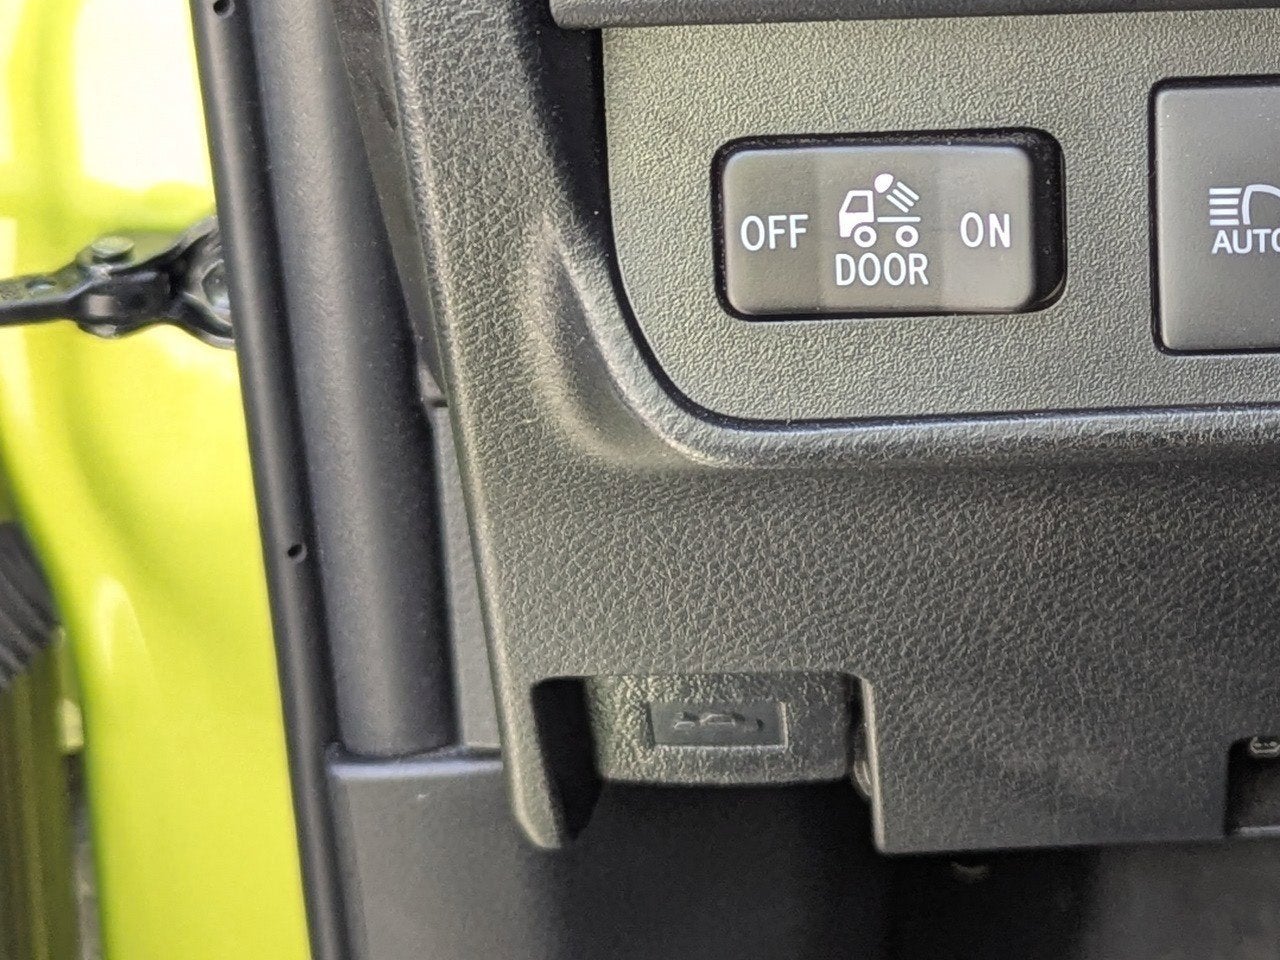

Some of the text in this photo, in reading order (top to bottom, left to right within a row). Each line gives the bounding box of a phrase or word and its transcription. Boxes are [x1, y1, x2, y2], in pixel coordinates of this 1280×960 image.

[740, 214, 810, 251] OFF
[959, 211, 1012, 248] ON
[834, 252, 929, 286] DOOR
